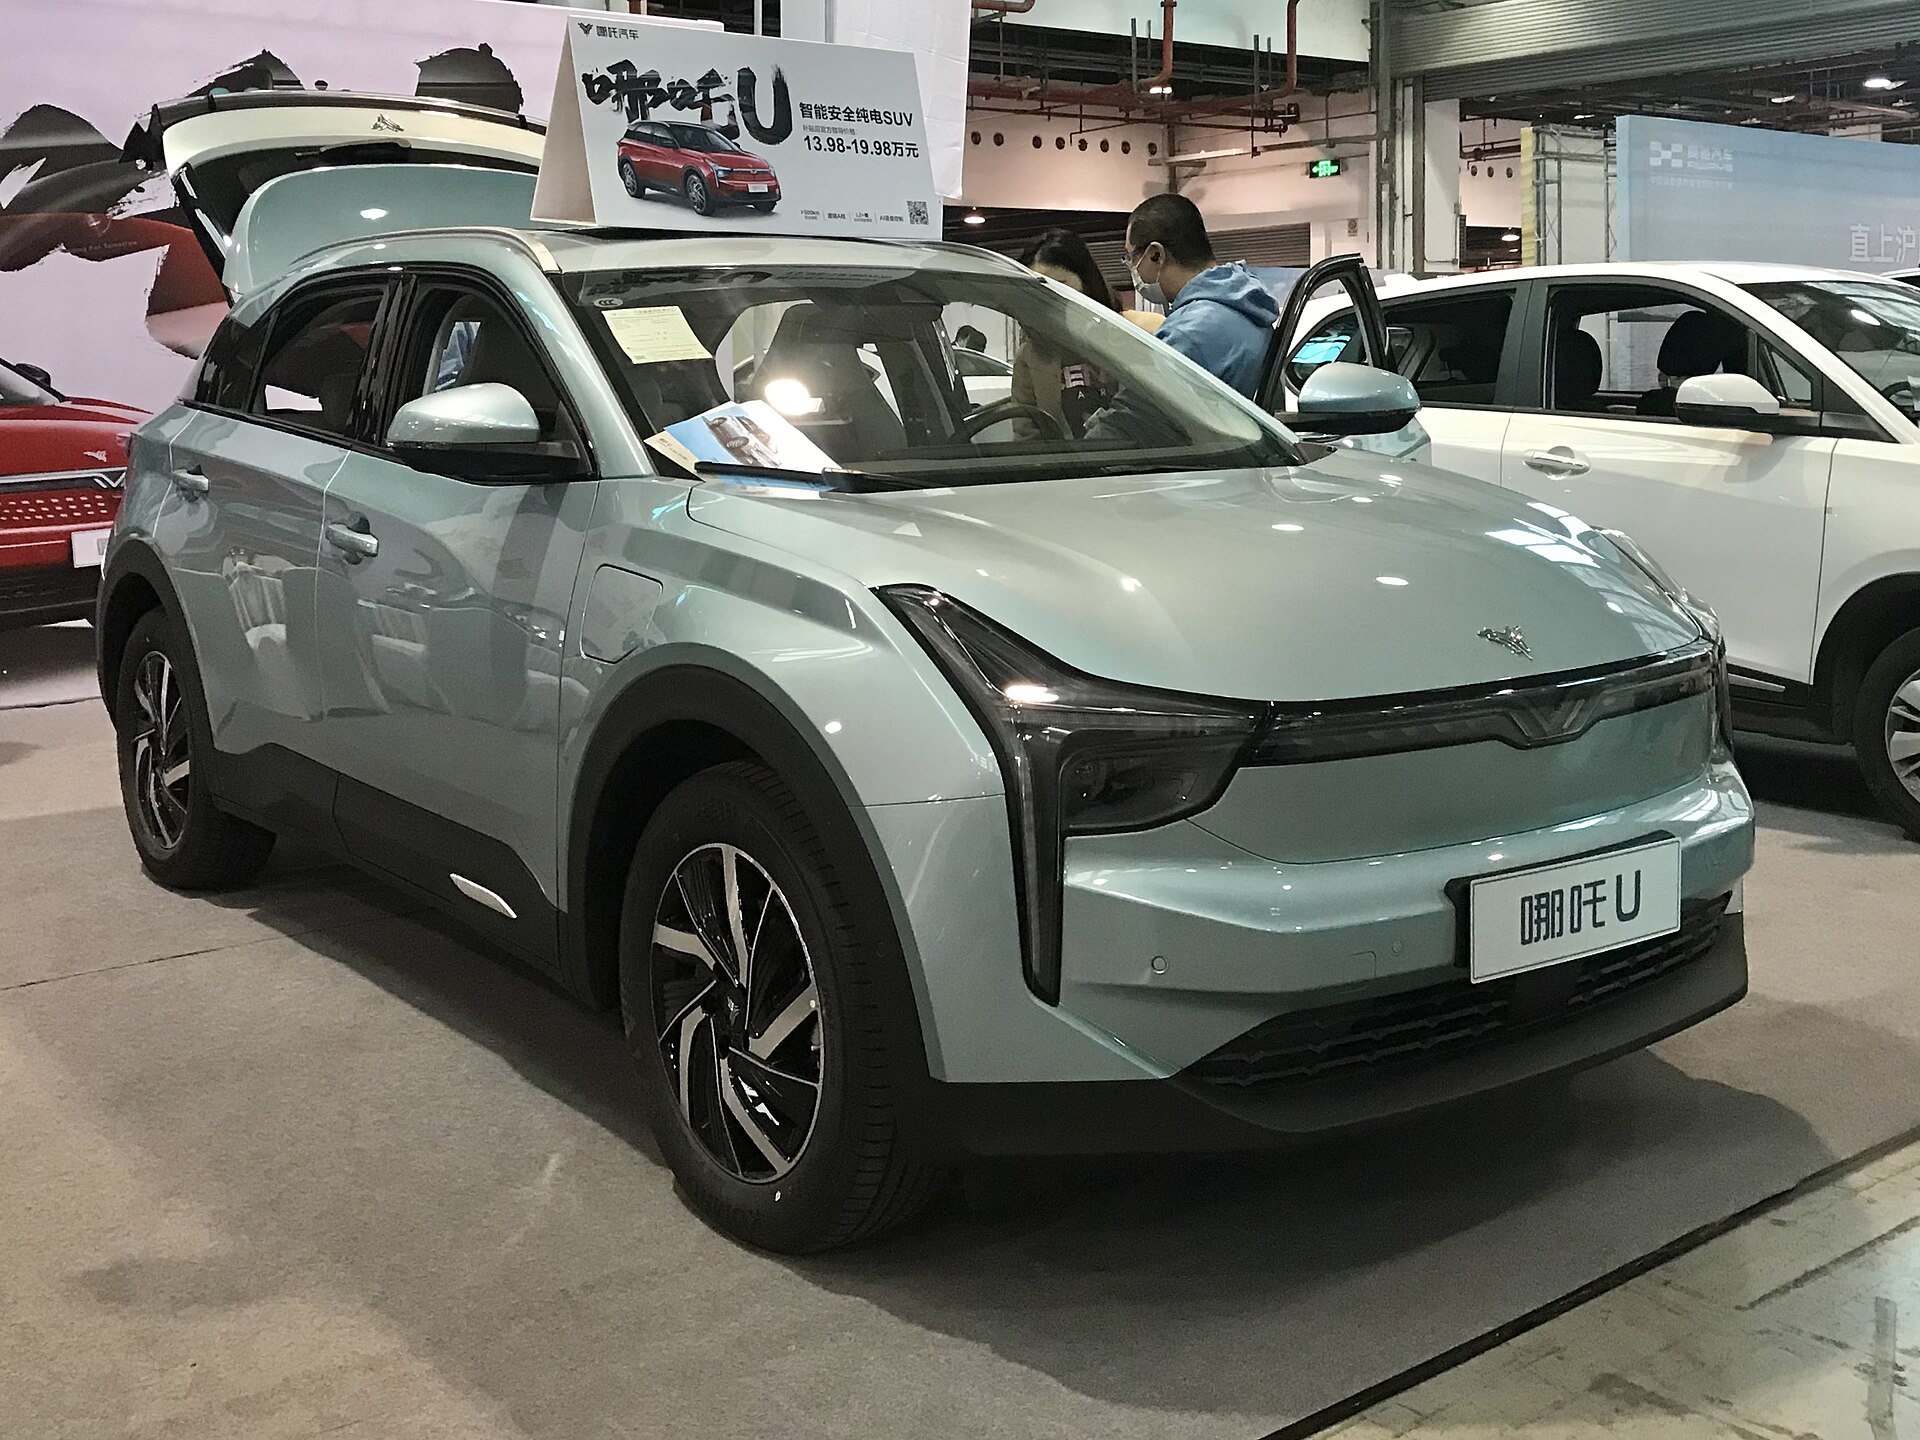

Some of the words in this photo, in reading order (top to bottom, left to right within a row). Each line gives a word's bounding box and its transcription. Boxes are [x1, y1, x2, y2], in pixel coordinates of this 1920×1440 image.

[799, 102, 913, 127] 智能安全纯电SUV
[803, 135, 920, 158] 13.98-19.98万元
[1849, 223, 1920, 264] 直上沪
